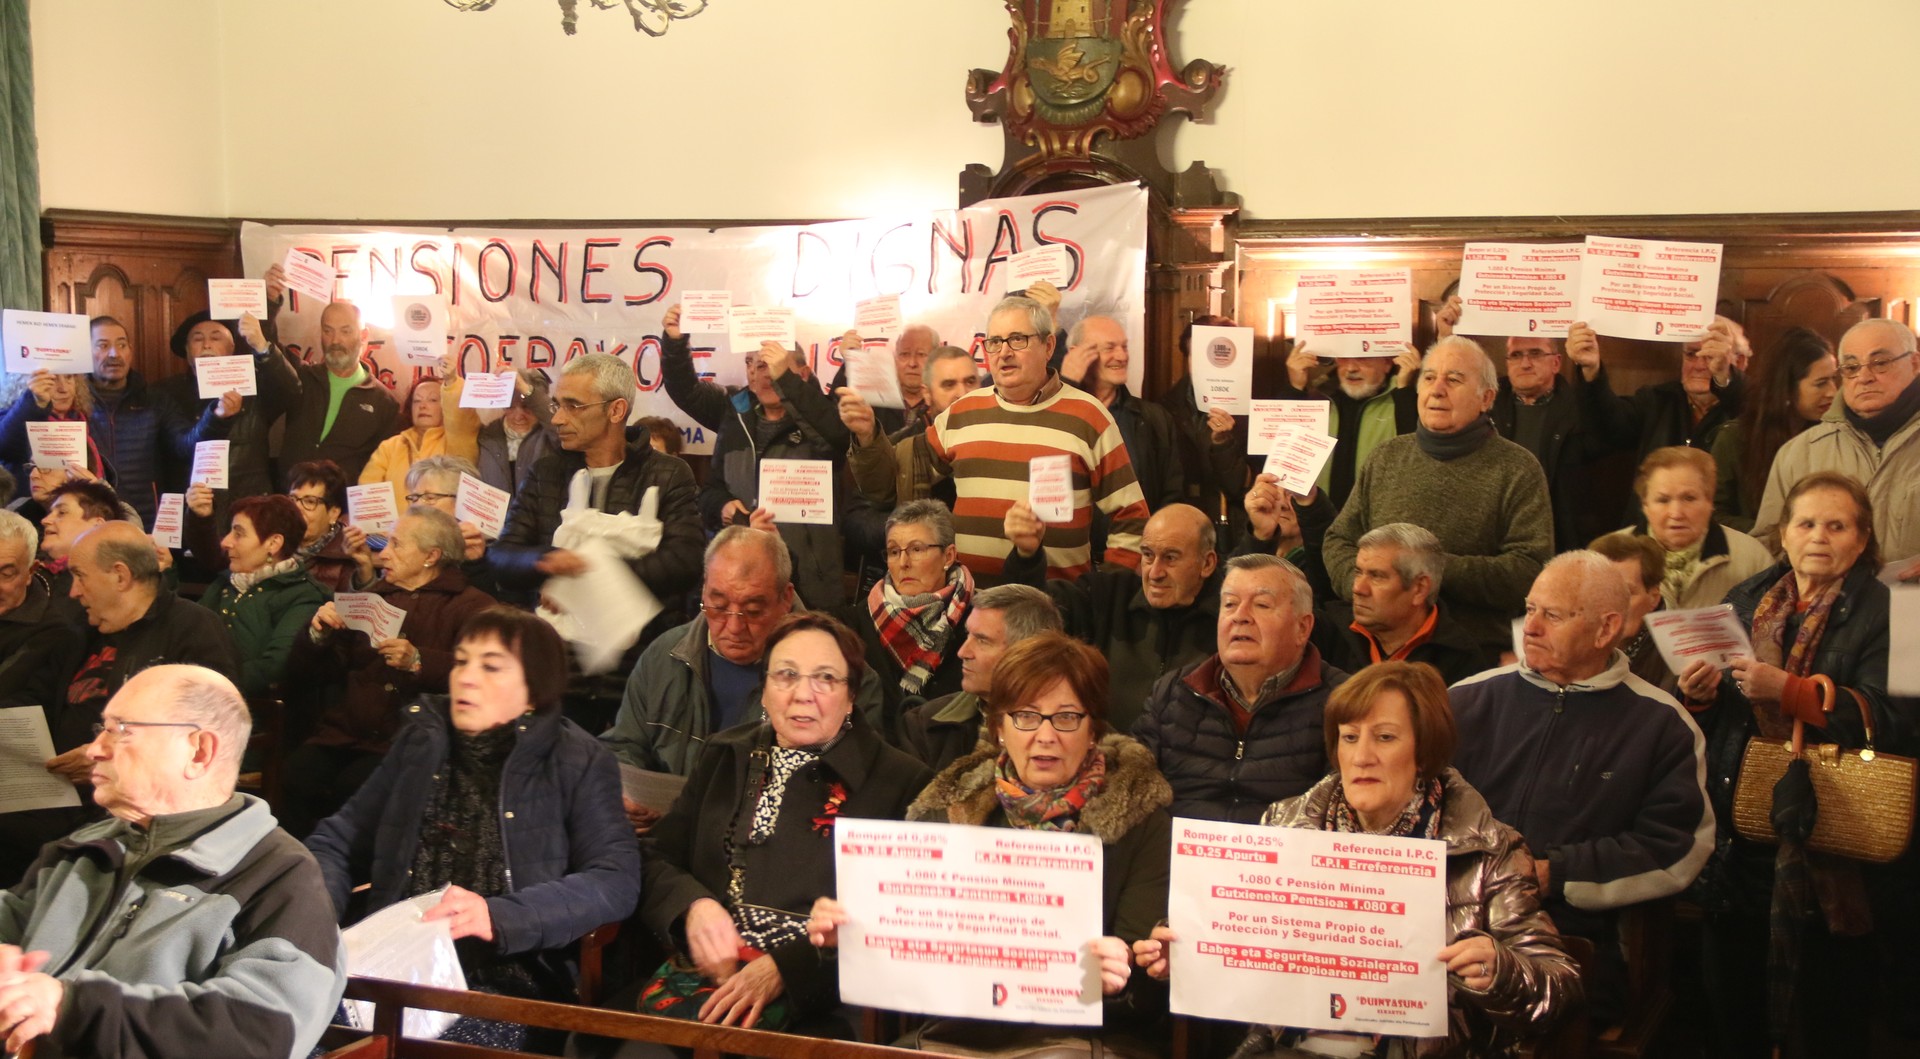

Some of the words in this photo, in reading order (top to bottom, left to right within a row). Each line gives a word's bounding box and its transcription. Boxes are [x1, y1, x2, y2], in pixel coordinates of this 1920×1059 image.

[792, 201, 1085, 298] DIGNAS
[1184, 829, 1227, 842] Romper
[1232, 835, 1241, 843] el
[1246, 836, 1283, 846] 0,25%
[1183, 845, 1193, 854] %
[1196, 847, 1221, 857] 0,25
[1225, 850, 1266, 861] Apurtu
[1333, 843, 1402, 856] Referencia
[1407, 849, 1438, 860] I.P.C.
[1313, 857, 1344, 868] K.P.I.
[1349, 860, 1432, 876] Erreferentzia
[1239, 874, 1270, 884] 1.080
[1276, 877, 1282, 886] €
[1288, 878, 1335, 890] Pensión
[1216, 887, 1286, 902] Gutxieneko
[1291, 894, 1348, 908] Pentsioa:
[1352, 900, 1387, 912] 1.080
[1391, 904, 1399, 913] €
[1212, 922, 1278, 935] Protección
[1282, 931, 1288, 939] y
[1293, 929, 1355, 943] Seguridad
[1360, 936, 1402, 948] Social.
[1229, 912, 1248, 921] Por
[1272, 916, 1321, 928] Sistema
[1326, 921, 1365, 933] Propio
[1370, 926, 1384, 935] de
[1200, 943, 1237, 955] Babes
[1265, 949, 1336, 965] Segurtasun
[1340, 957, 1415, 972] Sozialerako
[1226, 957, 1284, 971] Erakunde
[1288, 963, 1356, 978] Propioaren
[1360, 972, 1387, 981] alde
